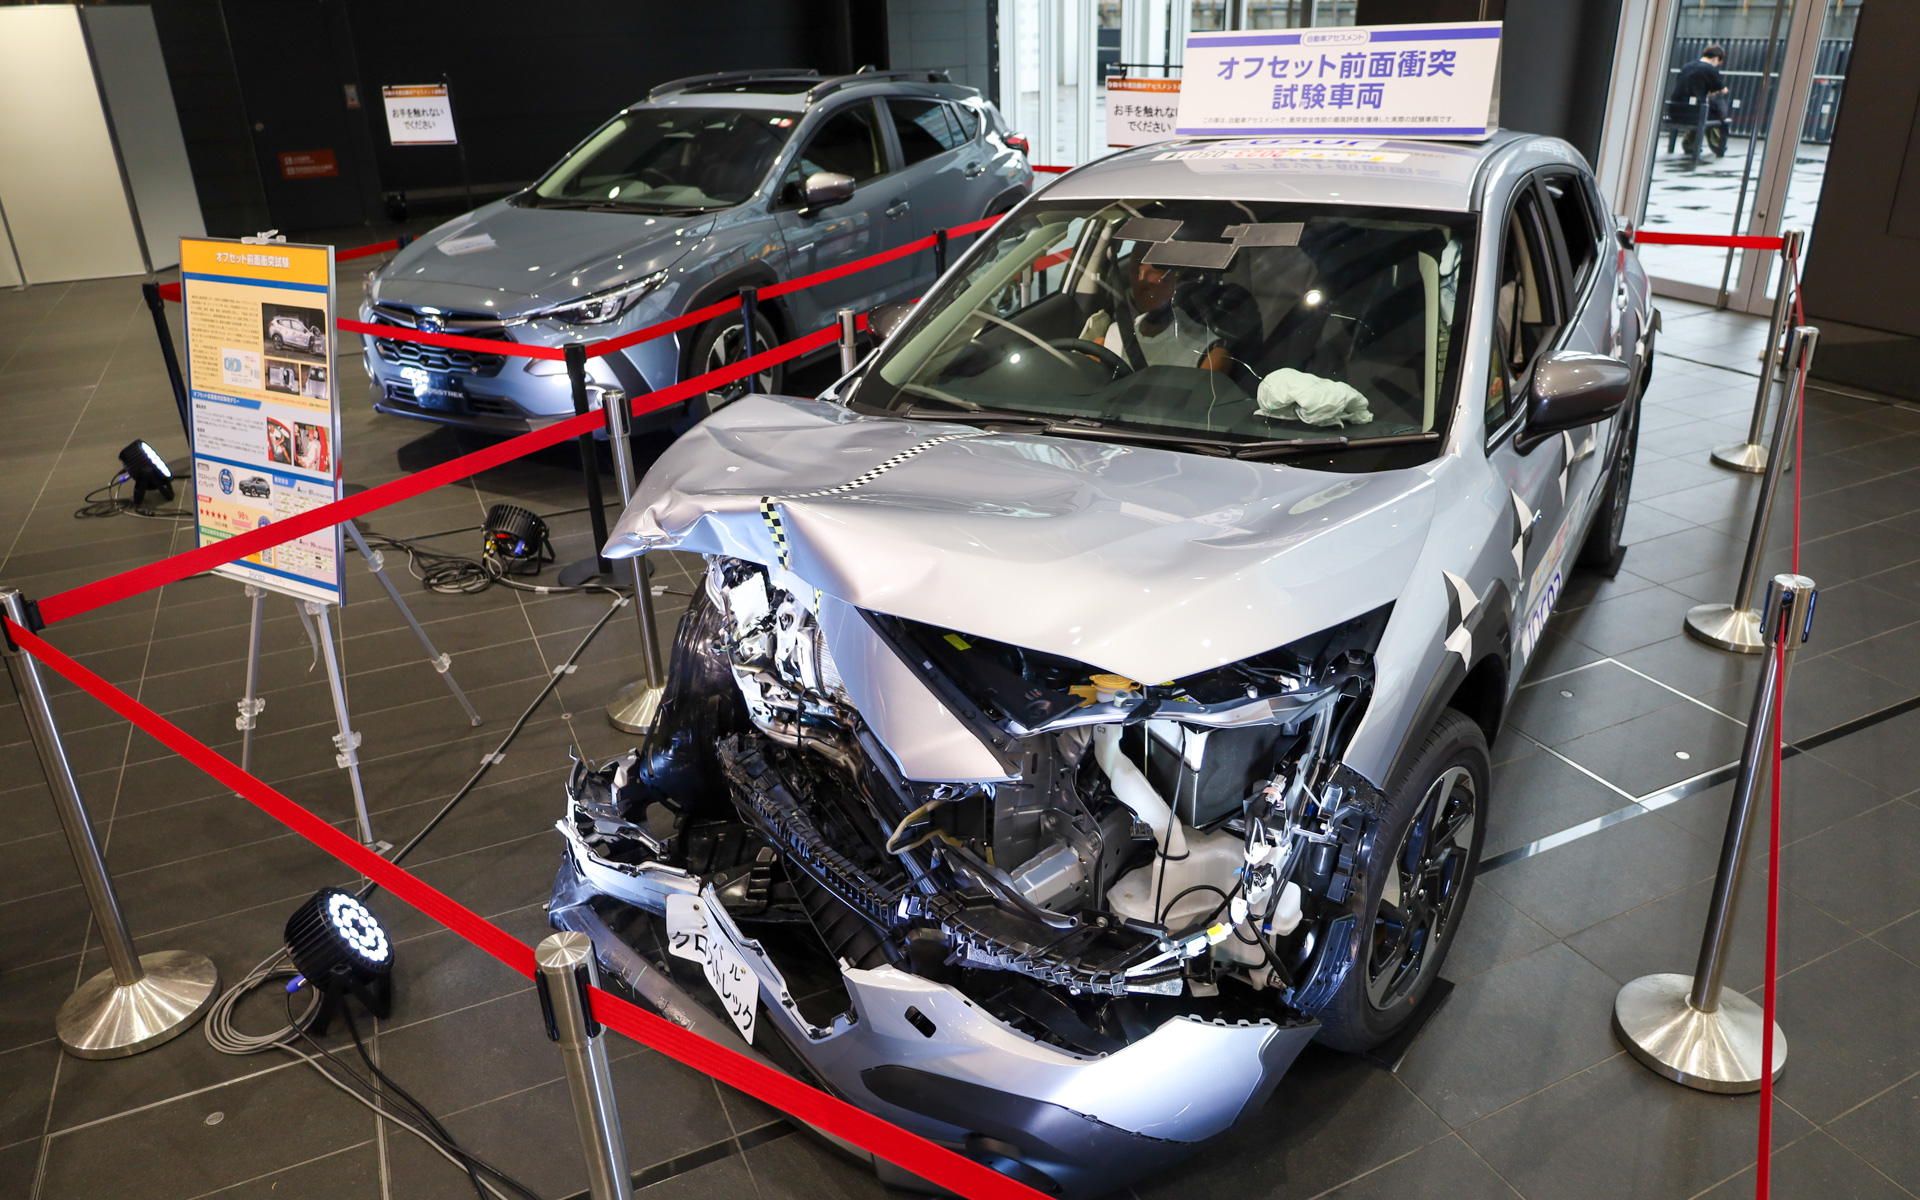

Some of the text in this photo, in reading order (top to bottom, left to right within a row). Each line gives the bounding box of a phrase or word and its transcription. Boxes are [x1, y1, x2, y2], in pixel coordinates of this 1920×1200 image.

[1307, 34, 1365, 43] 自動車アセスメント
[1217, 49, 1456, 81] オフセット前面衝突
[1271, 82, 1385, 110] 試験車両
[392, 108, 444, 118] お手を触れない
[404, 120, 436, 130] でください
[1128, 121, 1171, 133] でください
[216, 252, 290, 269] オフセット前面衝突試験
